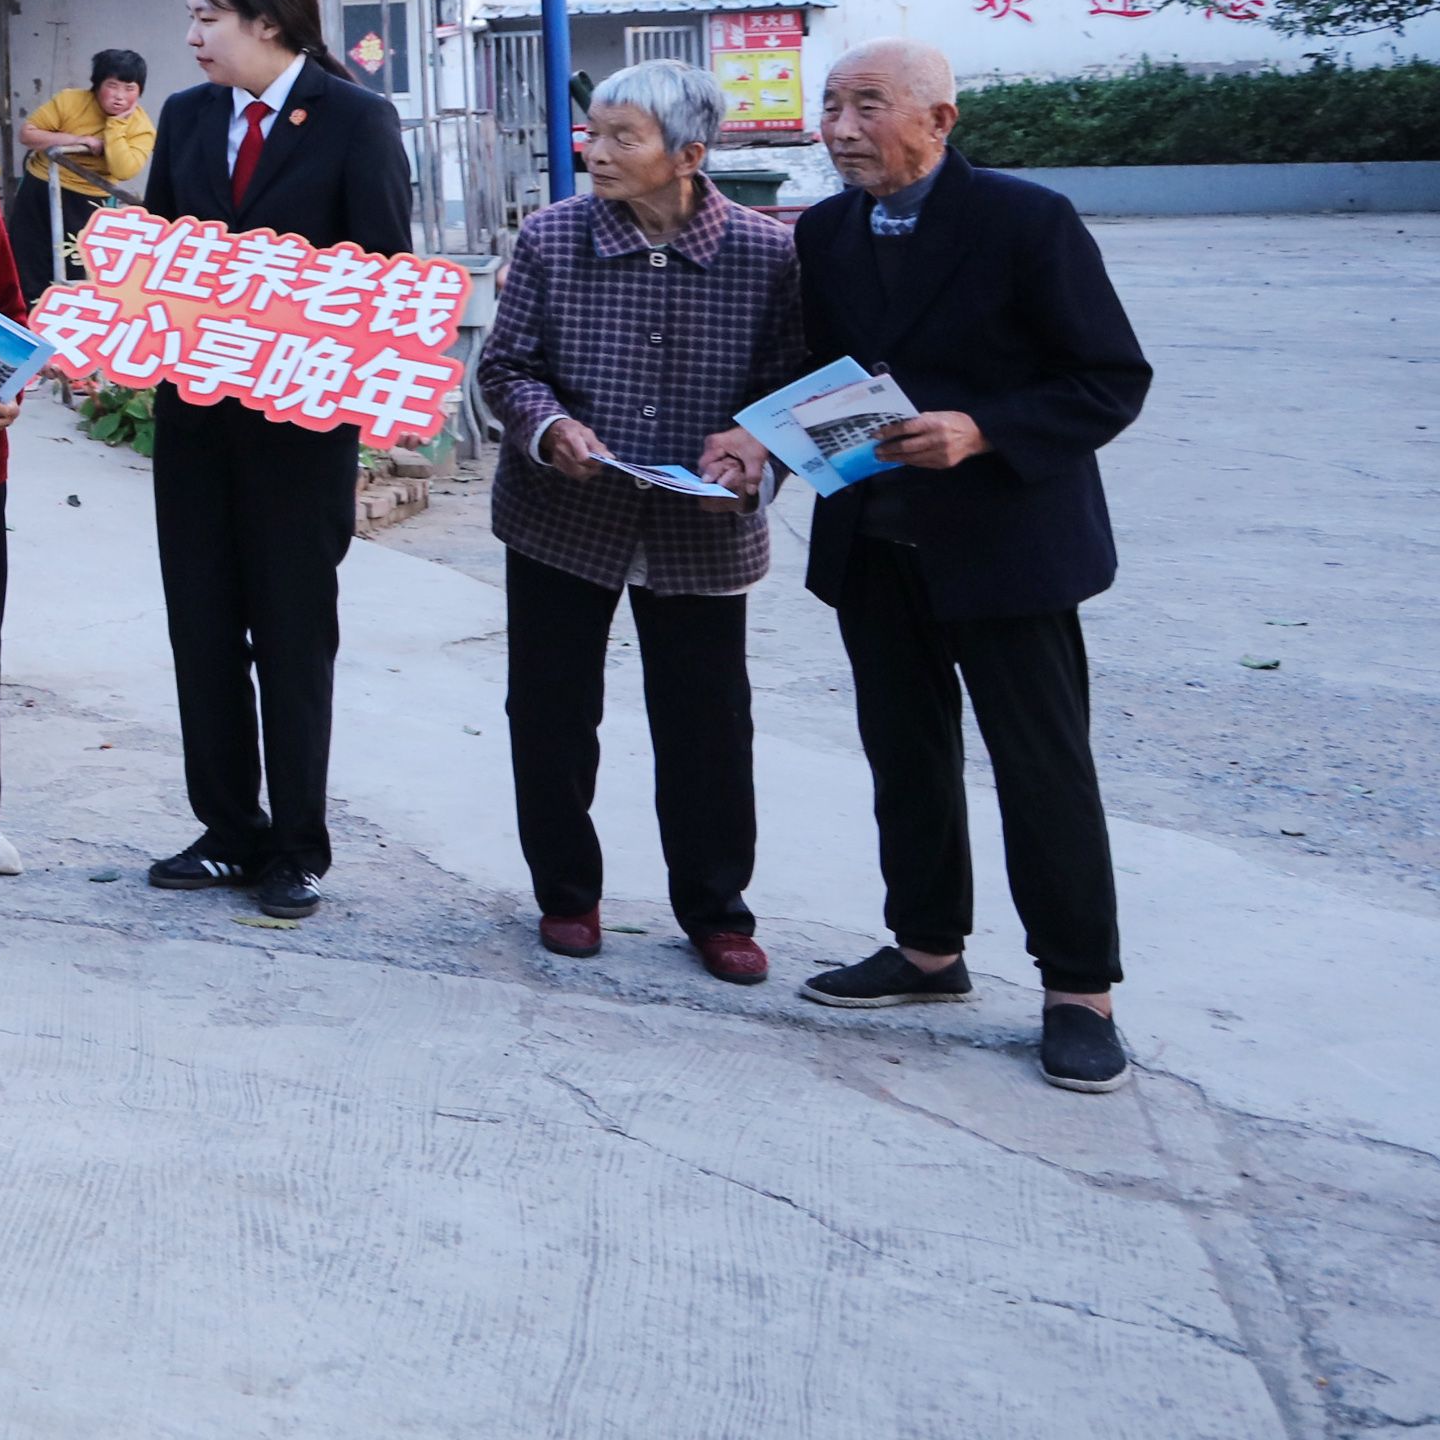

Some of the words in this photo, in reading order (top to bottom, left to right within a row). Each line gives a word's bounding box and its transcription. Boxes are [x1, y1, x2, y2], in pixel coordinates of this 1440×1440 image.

[84, 212, 466, 347] 守住养老钱
[34, 287, 457, 440] 安心享晚年
